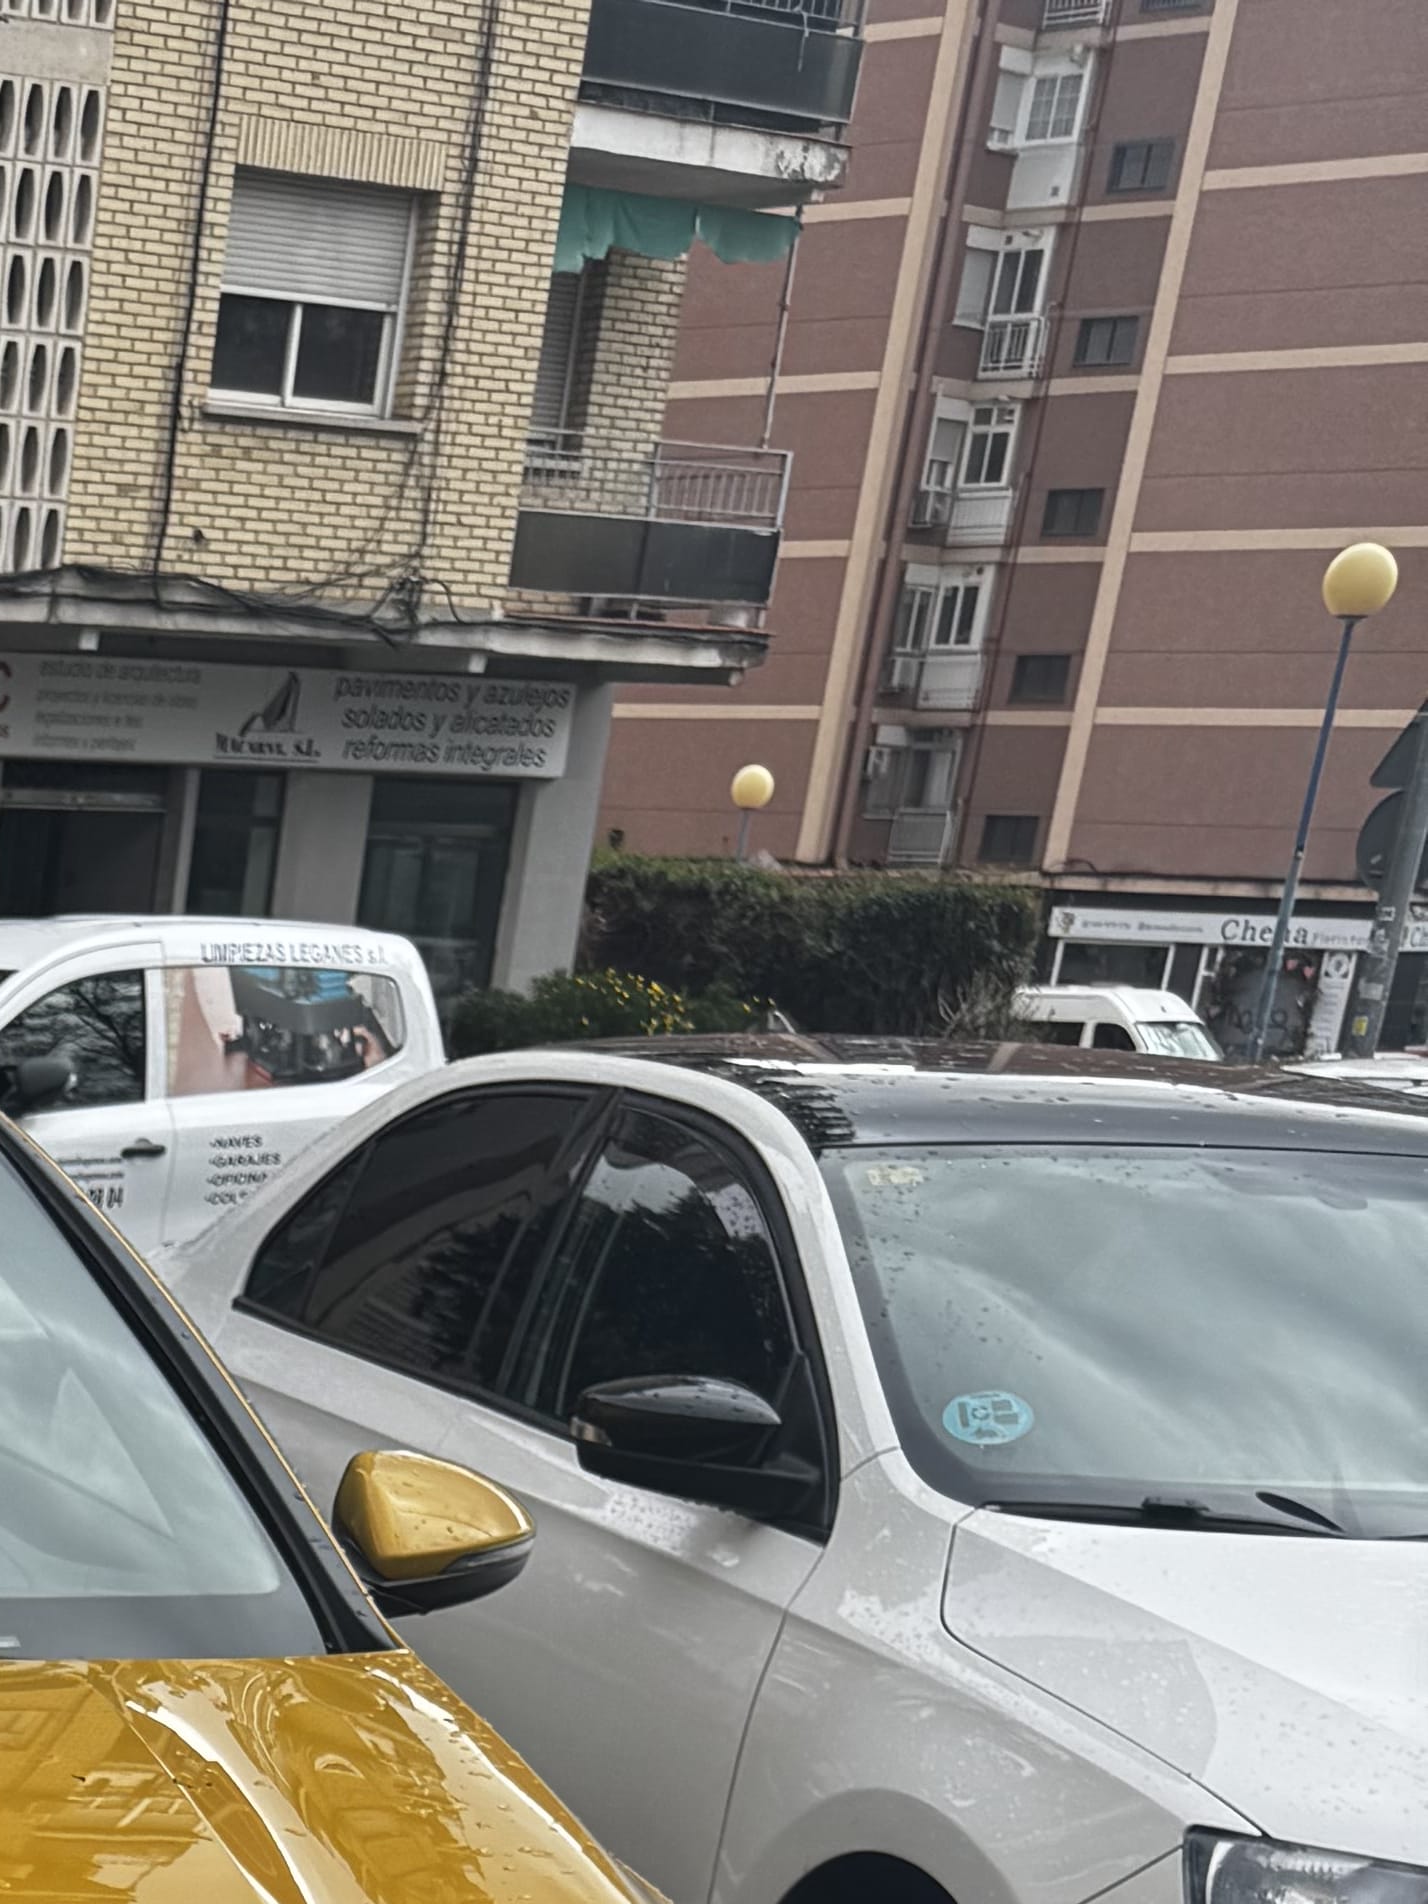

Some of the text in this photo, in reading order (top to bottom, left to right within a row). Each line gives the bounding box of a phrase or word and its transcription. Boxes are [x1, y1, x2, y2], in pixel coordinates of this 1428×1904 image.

[335, 676, 571, 713] pavimentos y azulejos
[342, 704, 557, 739] solados y alicatados
[342, 733, 547, 771] reformas integrales
